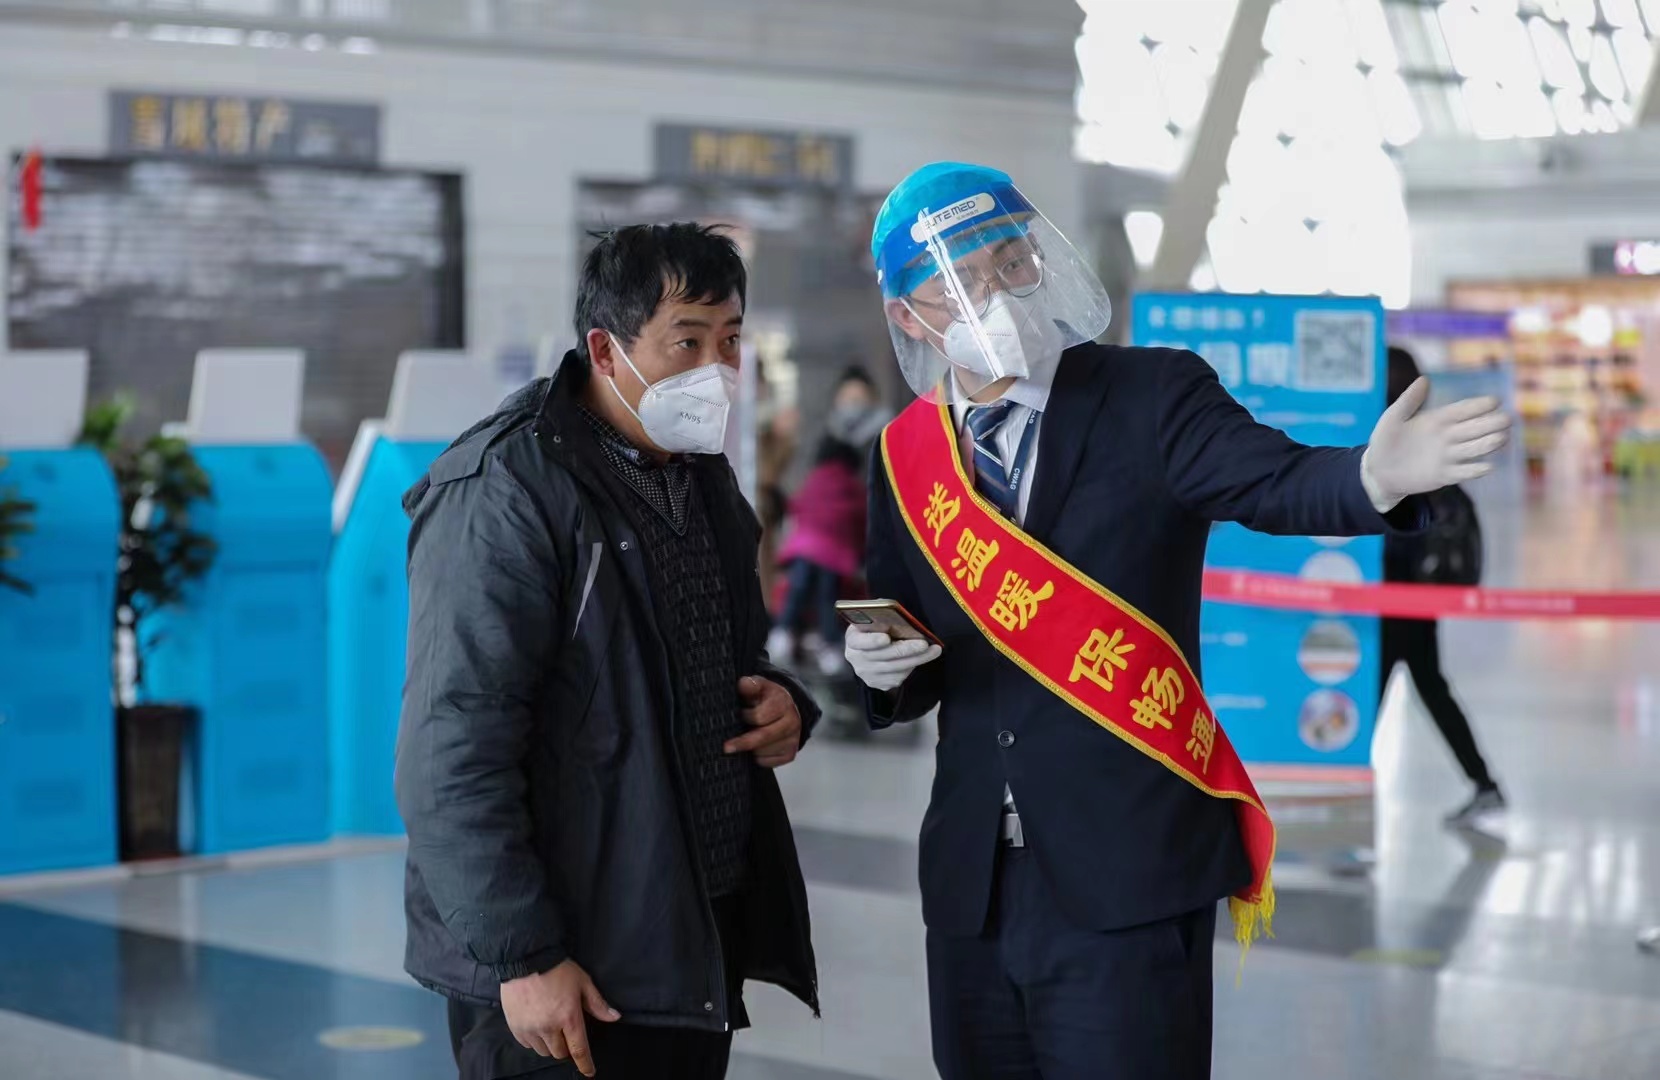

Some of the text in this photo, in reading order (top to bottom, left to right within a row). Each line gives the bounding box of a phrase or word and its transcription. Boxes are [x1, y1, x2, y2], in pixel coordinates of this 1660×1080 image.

[680, 411, 701, 424] KN95
[1009, 467, 1021, 491] CWAG
[922, 481, 1215, 775] 送温暖 保畅通
